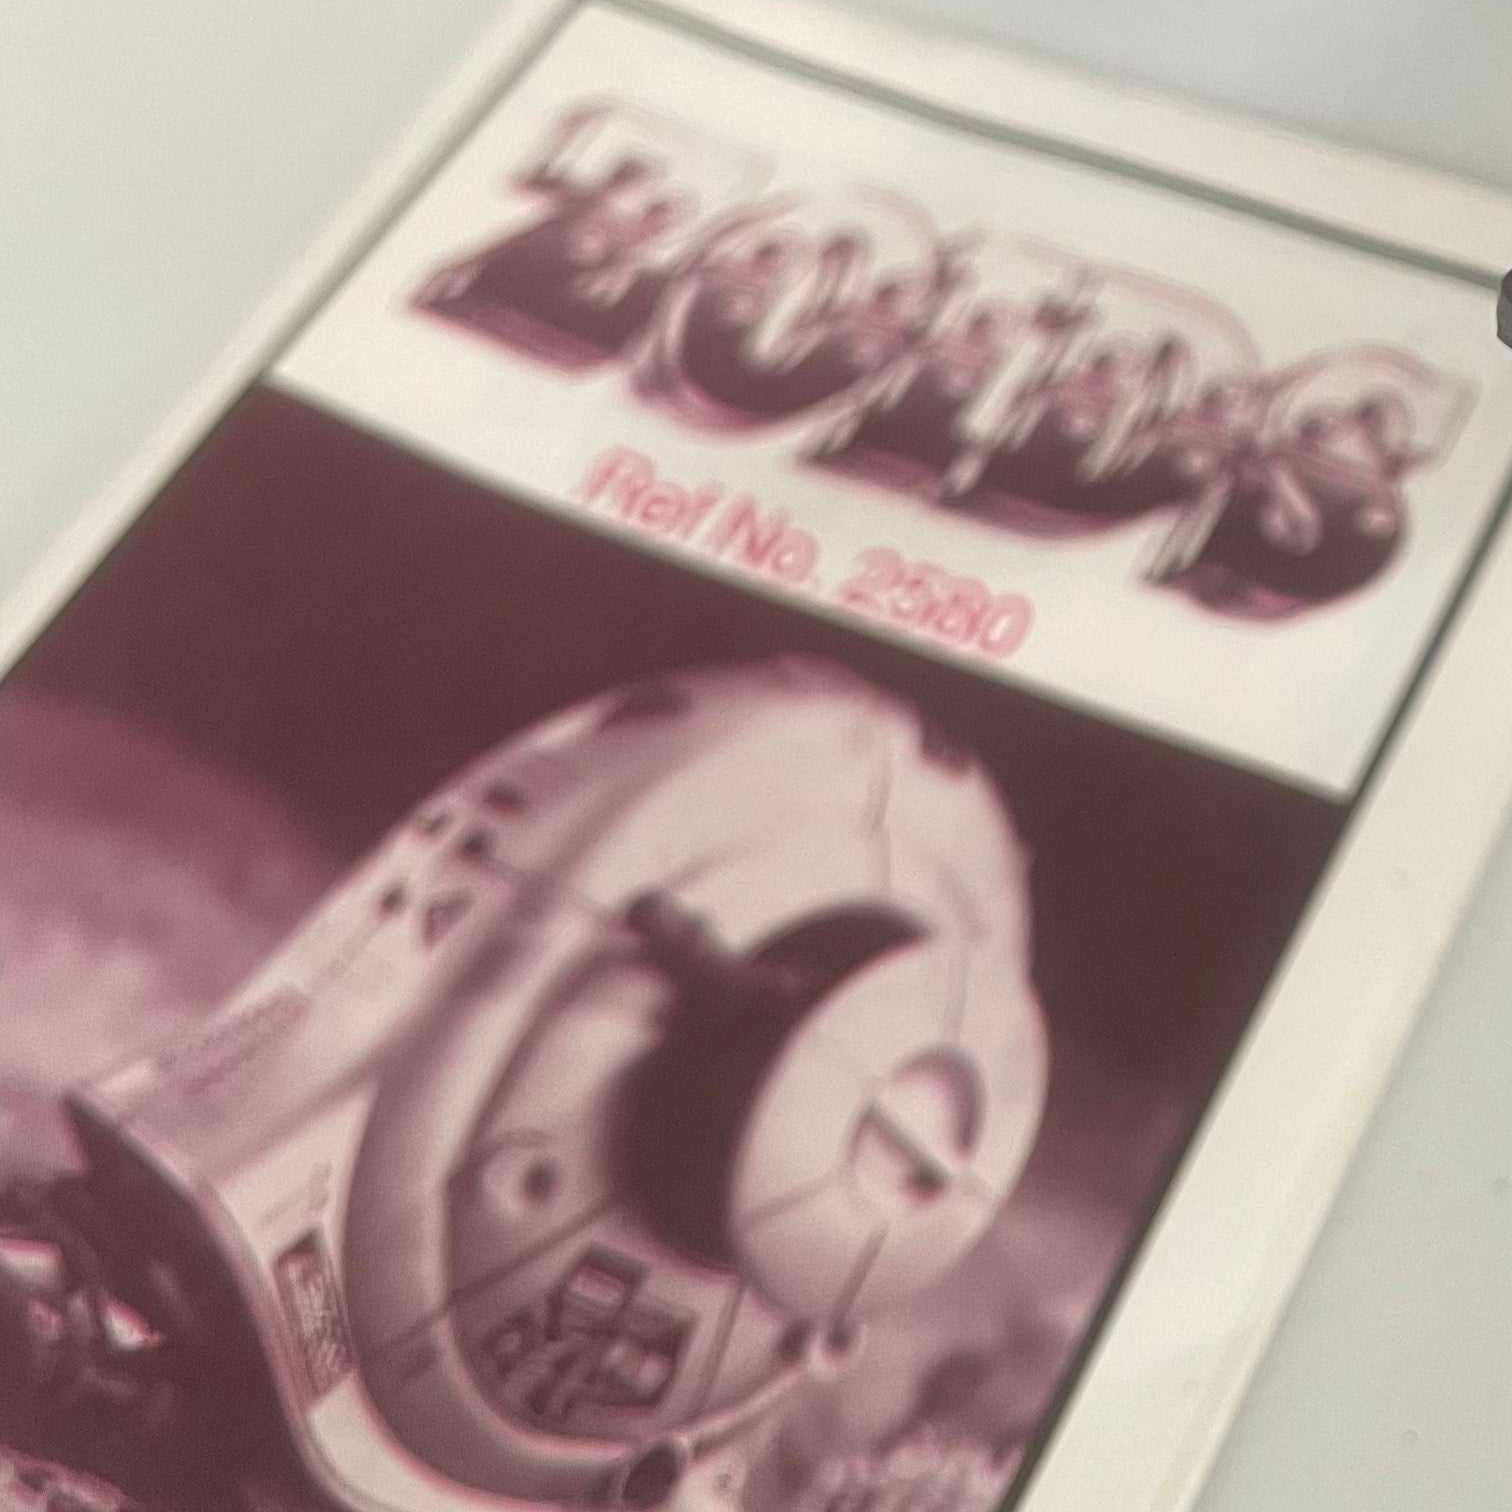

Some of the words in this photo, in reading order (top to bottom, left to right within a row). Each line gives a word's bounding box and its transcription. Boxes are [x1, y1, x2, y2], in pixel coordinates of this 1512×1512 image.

[406, 98, 1484, 622] ZOIDS
[581, 445, 726, 539] Ref
[708, 492, 822, 592] No.
[841, 545, 1037, 660] 2580
